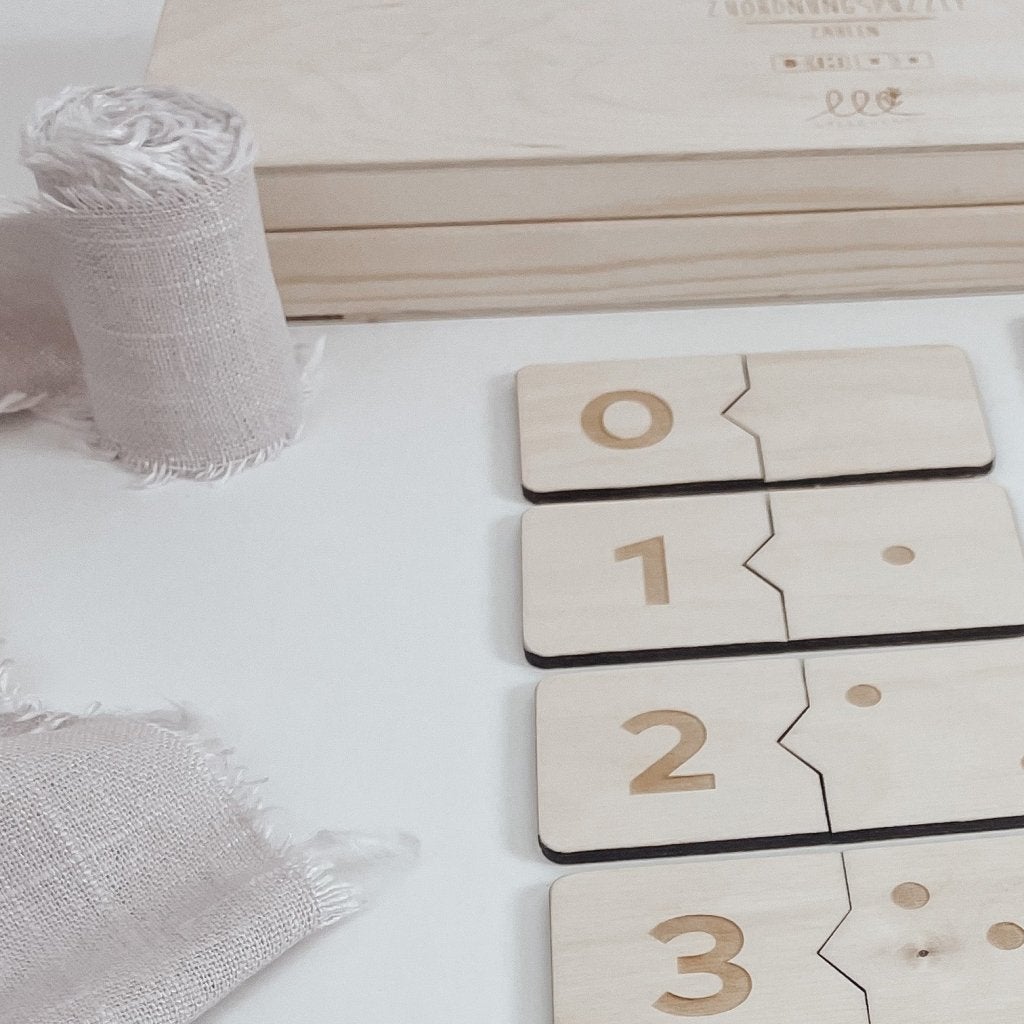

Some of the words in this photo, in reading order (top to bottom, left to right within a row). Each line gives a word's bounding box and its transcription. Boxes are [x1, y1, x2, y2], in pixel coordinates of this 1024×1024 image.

[581, 390, 673, 449] 0
[614, 535, 670, 604] 1
[624, 709, 714, 794] 2
[651, 914, 752, 1015] 3
